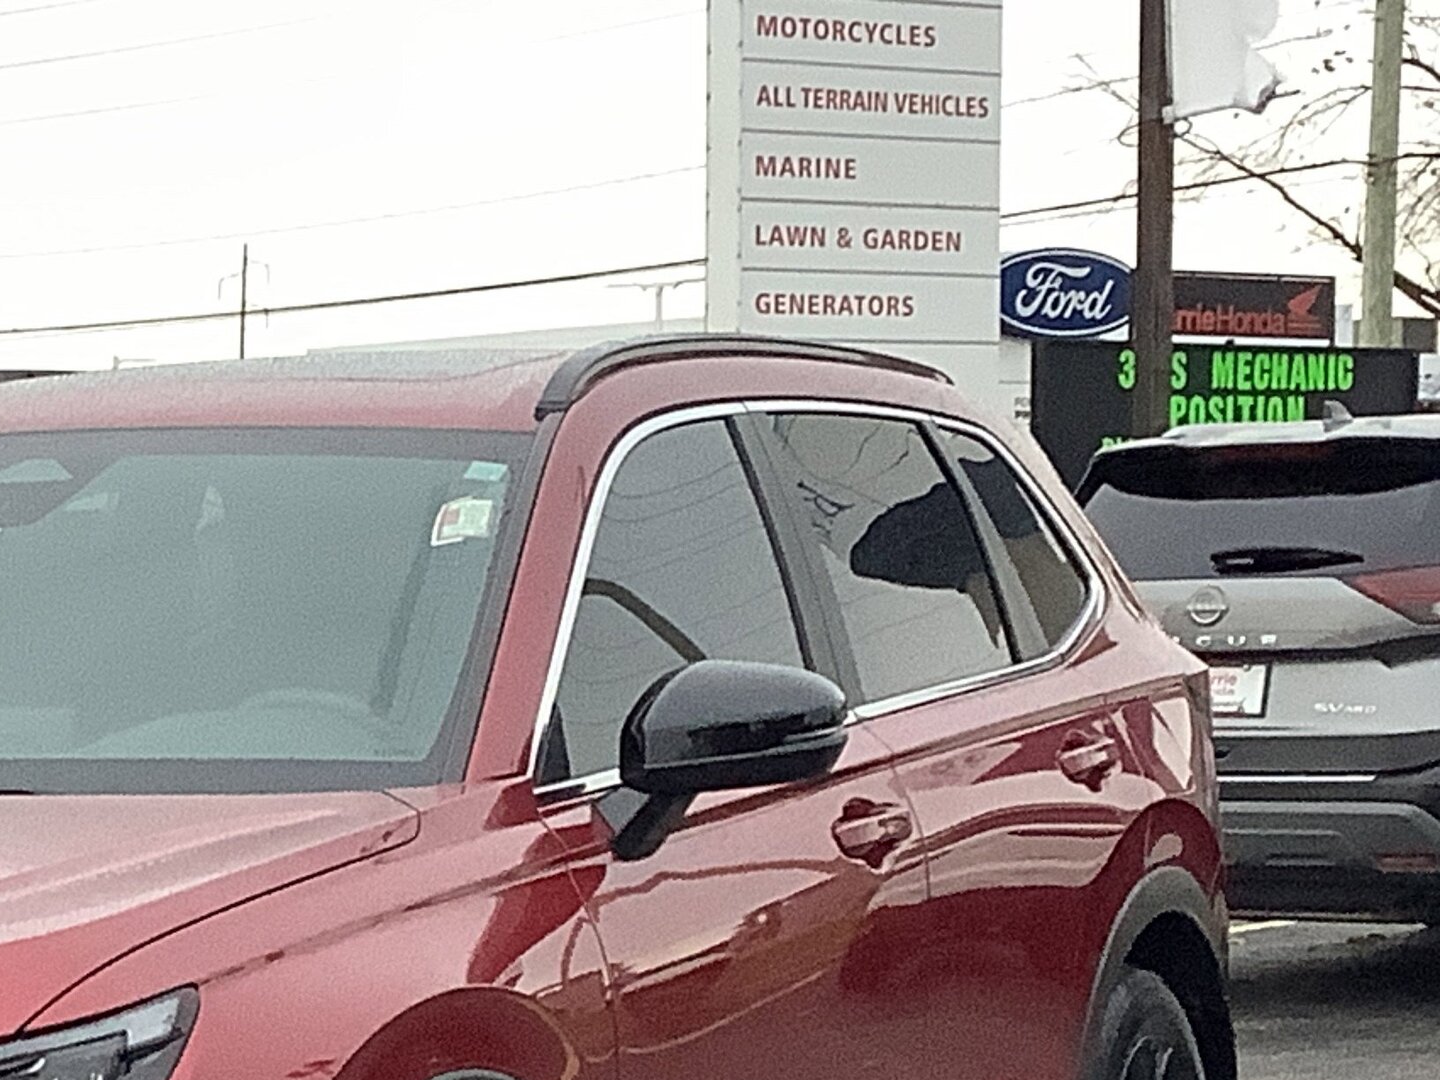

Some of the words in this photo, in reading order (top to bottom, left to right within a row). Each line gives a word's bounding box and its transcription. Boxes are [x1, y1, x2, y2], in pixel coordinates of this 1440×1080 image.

[756, 14, 937, 48] MOTORCYCLES
[756, 84, 796, 108] ALL
[801, 87, 888, 114] TERRAIN
[894, 92, 989, 119] VEHICLES
[755, 155, 857, 181] MARINE
[755, 224, 827, 249] LAWN
[836, 227, 853, 250] &
[863, 227, 962, 253] GARDEN
[754, 292, 915, 317] GENERATORS
[1014, 261, 1115, 321] Ford
[1211, 350, 1355, 392] MECHANIC
[1169, 394, 1306, 429] POSITION
